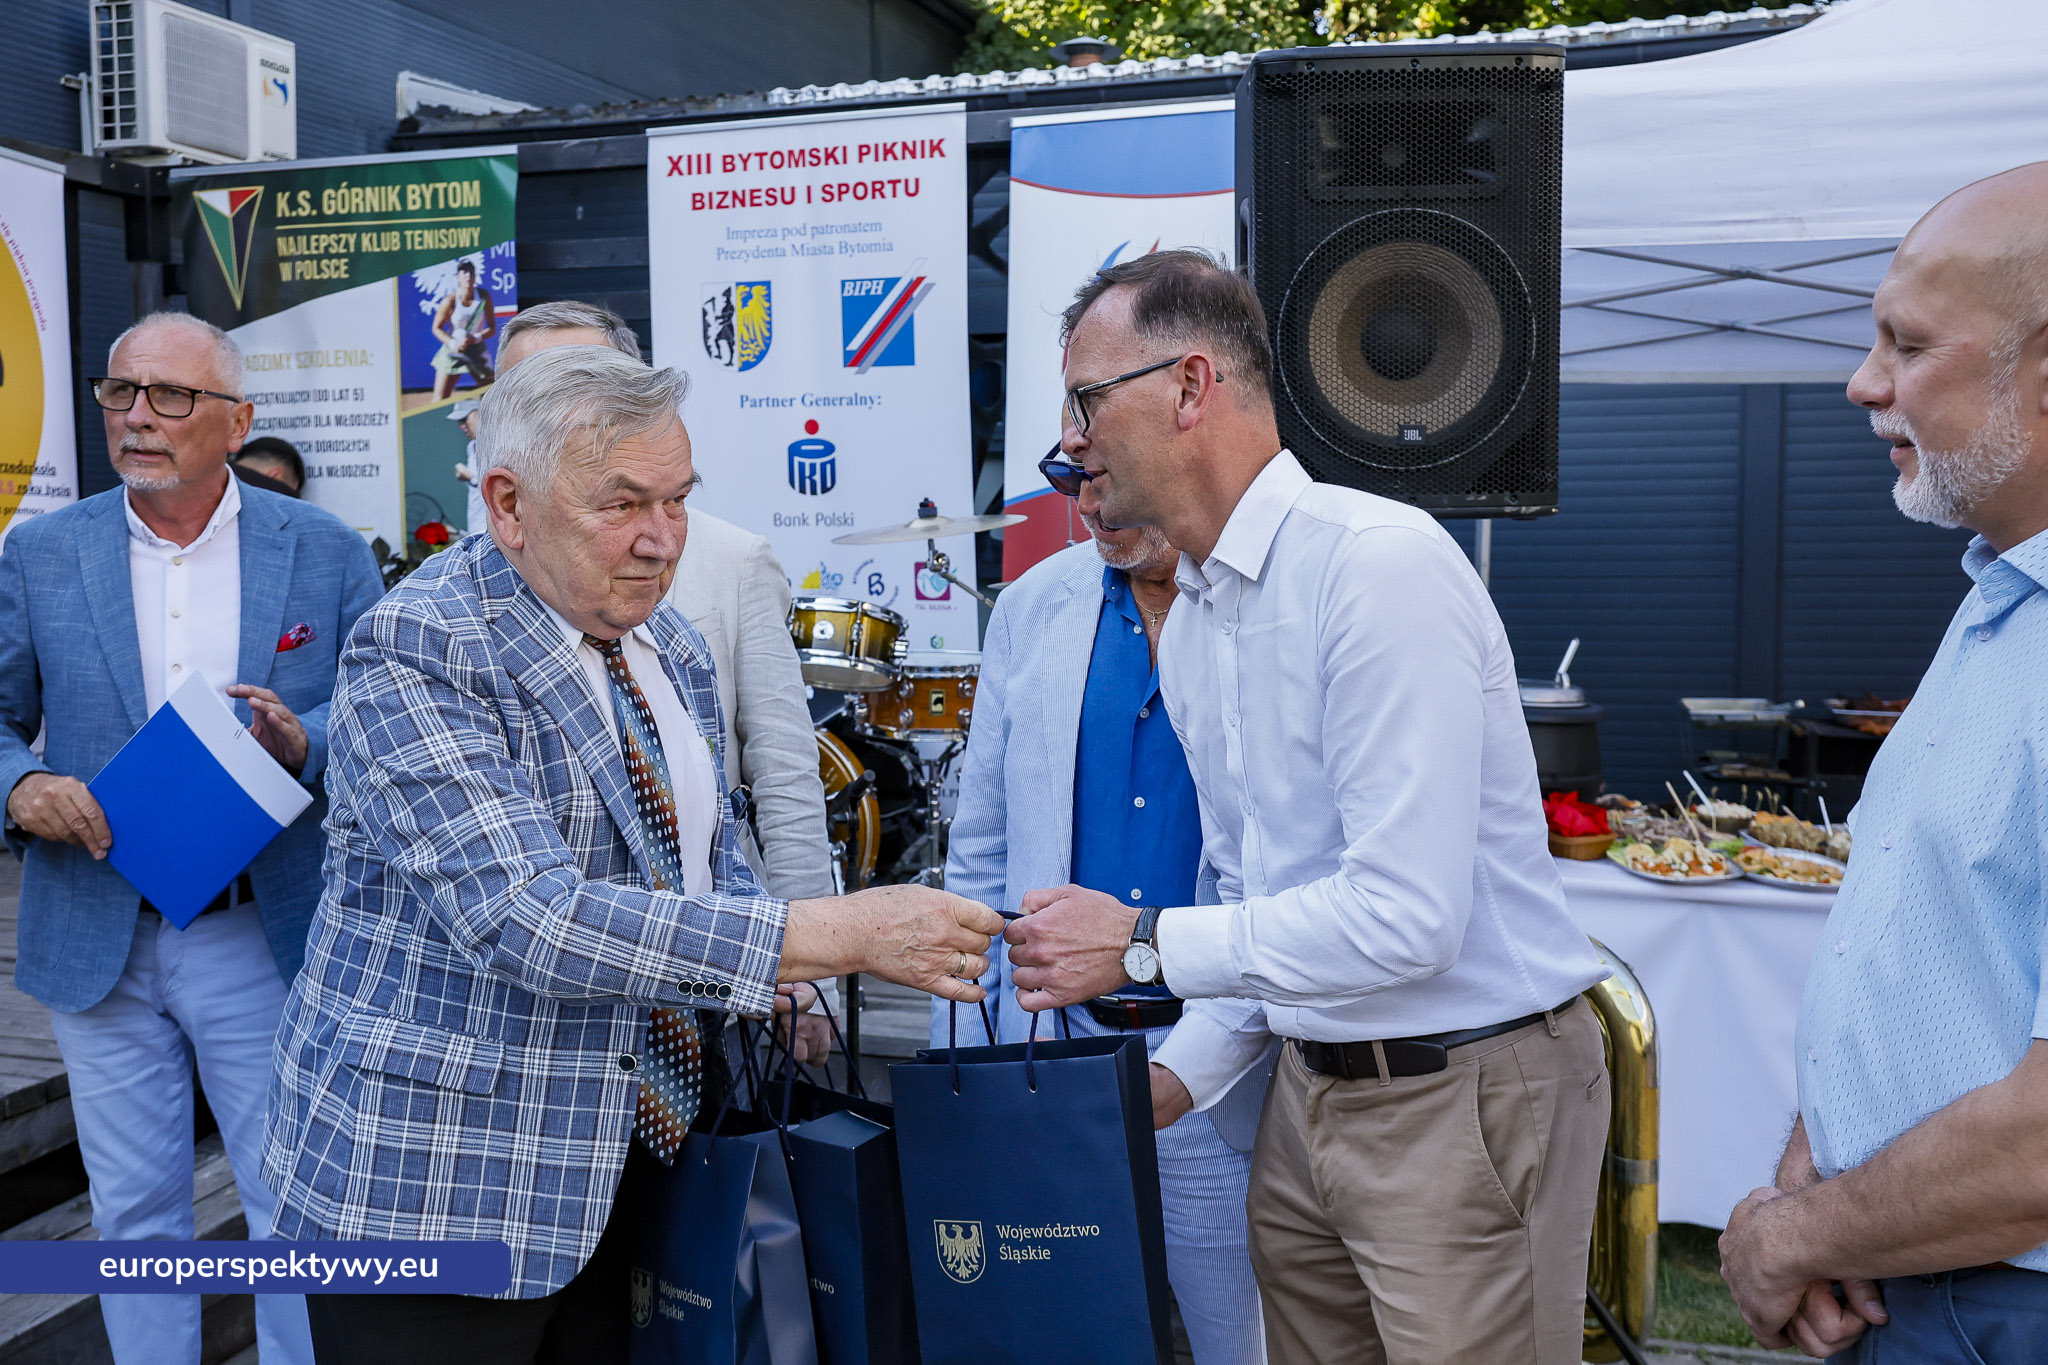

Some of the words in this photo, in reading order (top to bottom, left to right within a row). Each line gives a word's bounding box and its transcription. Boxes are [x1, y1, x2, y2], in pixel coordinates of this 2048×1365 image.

[666, 153, 712, 177] XIII
[722, 145, 848, 173] BYTOMSKI
[858, 138, 946, 163] PIKNIK
[276, 190, 317, 217] K.S.
[322, 182, 401, 215] GÓRNIK
[406, 180, 481, 211] BYTOM
[691, 186, 796, 211] BIZNESU
[806, 185, 812, 204] I
[821, 178, 920, 203] SPORTU
[277, 233, 357, 257] NAJLEPSZY
[361, 230, 400, 253] KLUB
[404, 227, 481, 250] TENISOWY
[726, 226, 778, 244] Impreza
[782, 223, 807, 240] pod
[811, 221, 883, 239] patronatem
[717, 245, 787, 263] Prezydenta
[791, 243, 835, 257] Miasta
[839, 238, 894, 257] Bytomia
[279, 262, 293, 282] W
[295, 258, 349, 280] POLSCE
[842, 279, 886, 297] BIPH
[739, 394, 796, 409] Partner
[801, 392, 882, 410] Generalny:
[1404, 429, 1422, 440] JBL
[773, 512, 810, 527] Bank
[816, 511, 855, 527] Polski
[995, 1223, 1100, 1242] Województwo
[999, 1243, 1051, 1264] Śląskie
[659, 1279, 712, 1310] Województwo
[659, 1300, 685, 1321] Śląskie
